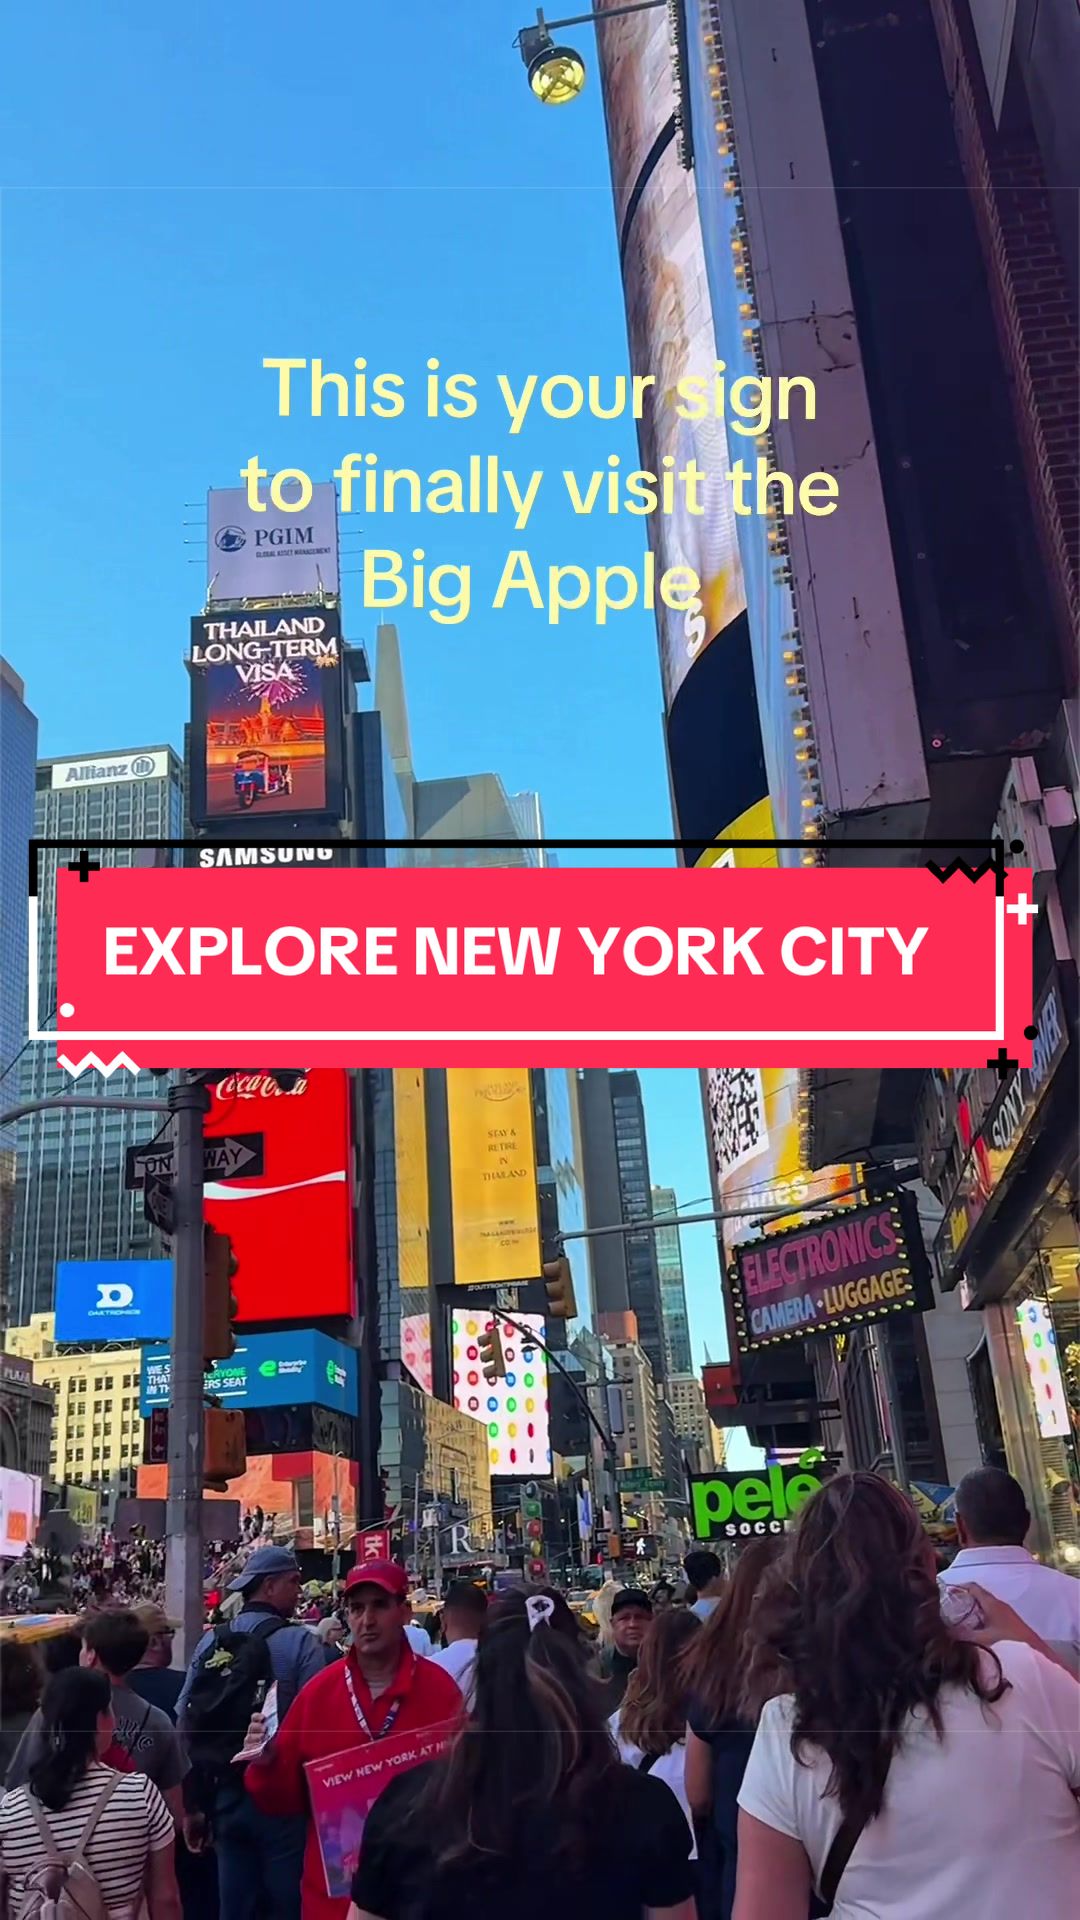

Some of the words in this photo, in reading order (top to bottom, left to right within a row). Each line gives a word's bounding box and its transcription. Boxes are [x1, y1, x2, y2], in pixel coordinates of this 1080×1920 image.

[254, 526, 314, 546] PGIM
[203, 616, 326, 641] THAILAND
[192, 637, 338, 664] LONG-TERM
[235, 661, 295, 683] VISA
[65, 761, 129, 783] Allianz
[198, 847, 333, 868] SAMSUNG
[991, 1068, 1027, 1151] SONY
[487, 1129, 508, 1138] STAY
[510, 1128, 516, 1136] &
[488, 1142, 518, 1152] RETIRE
[145, 1157, 173, 1174] ON
[204, 1147, 243, 1168] WAY
[499, 1156, 508, 1165] IN
[482, 1169, 527, 1181] THAILAND
[742, 1210, 897, 1297] ELECTRONICS
[750, 1295, 817, 1335] CAMERA
[823, 1268, 906, 1316] LUGGAGE
[222, 1377, 248, 1388] SEAT
[451, 1524, 478, 1554] R
[725, 1520, 787, 1537] SOCC
[322, 1770, 354, 1788] VIEW
[356, 1761, 384, 1778] NEW
[385, 1749, 416, 1768] YORK
[419, 1743, 435, 1758] AT
